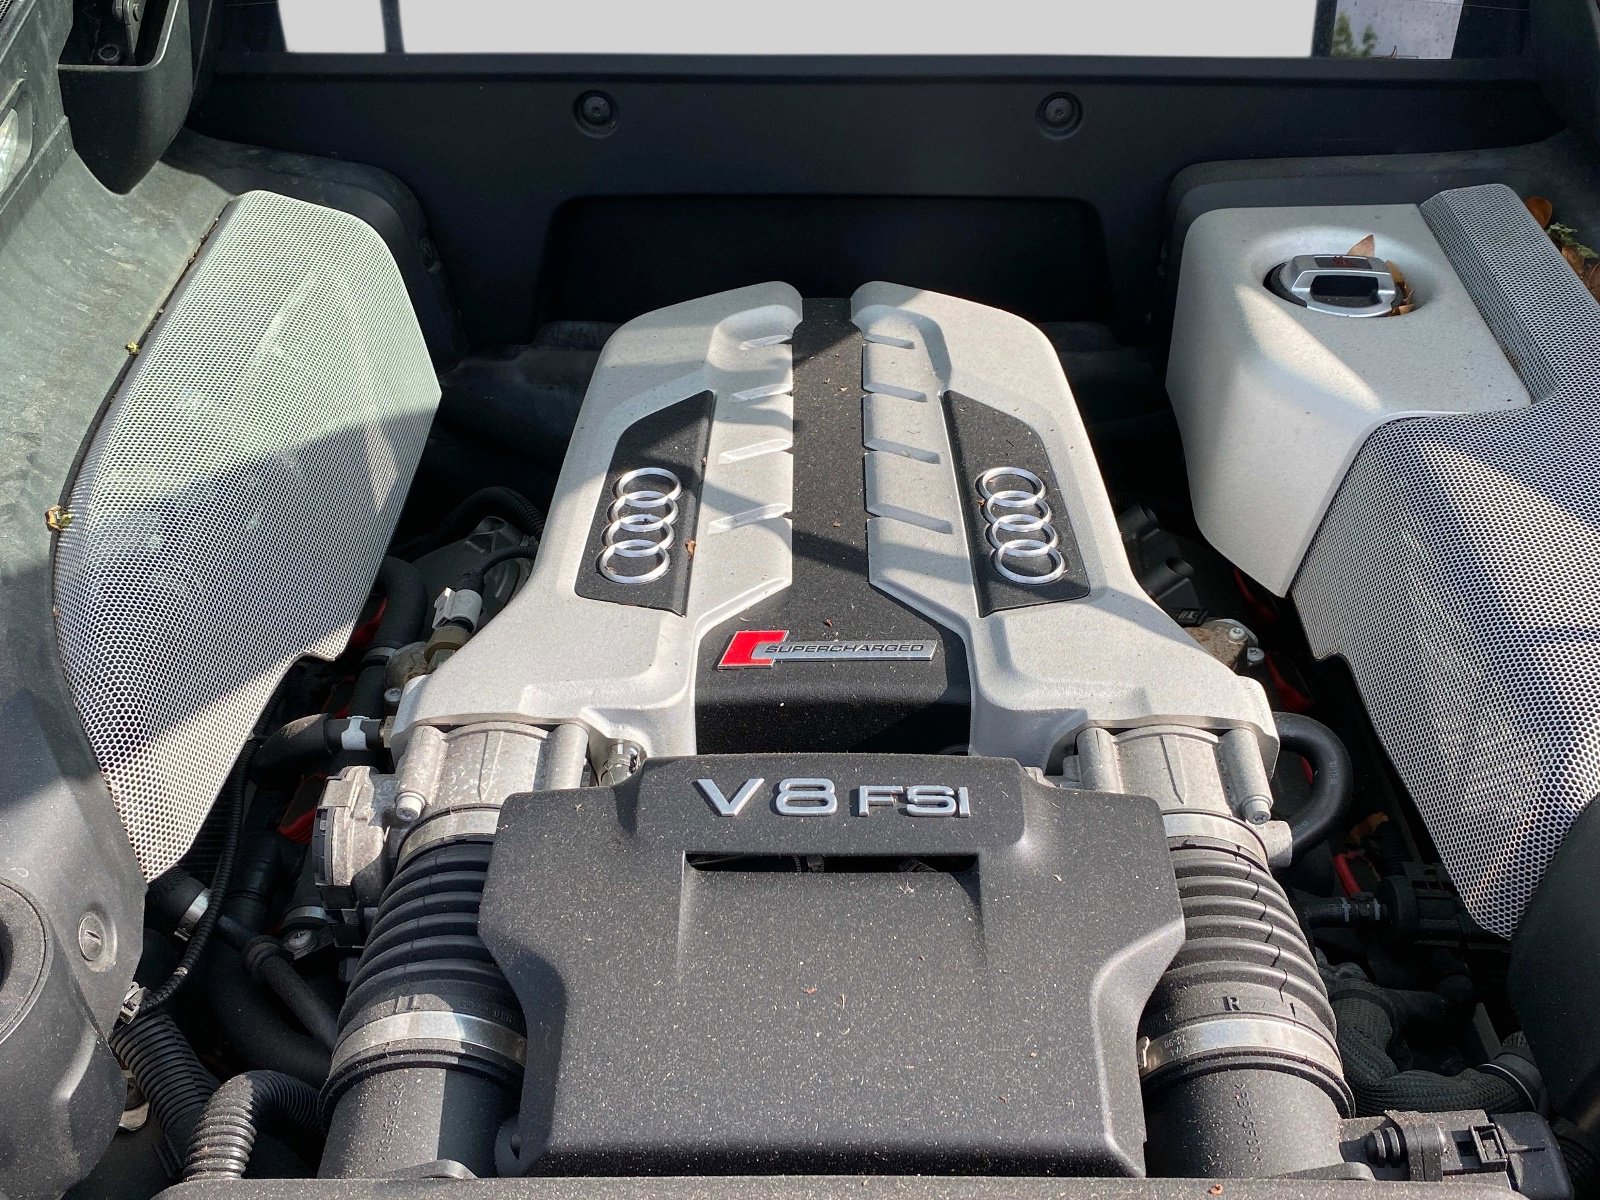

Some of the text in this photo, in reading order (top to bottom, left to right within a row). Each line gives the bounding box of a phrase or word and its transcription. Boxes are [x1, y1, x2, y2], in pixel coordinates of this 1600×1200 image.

[765, 643, 925, 653] SUPERCHARGED
[696, 777, 971, 818] V8 FSI
